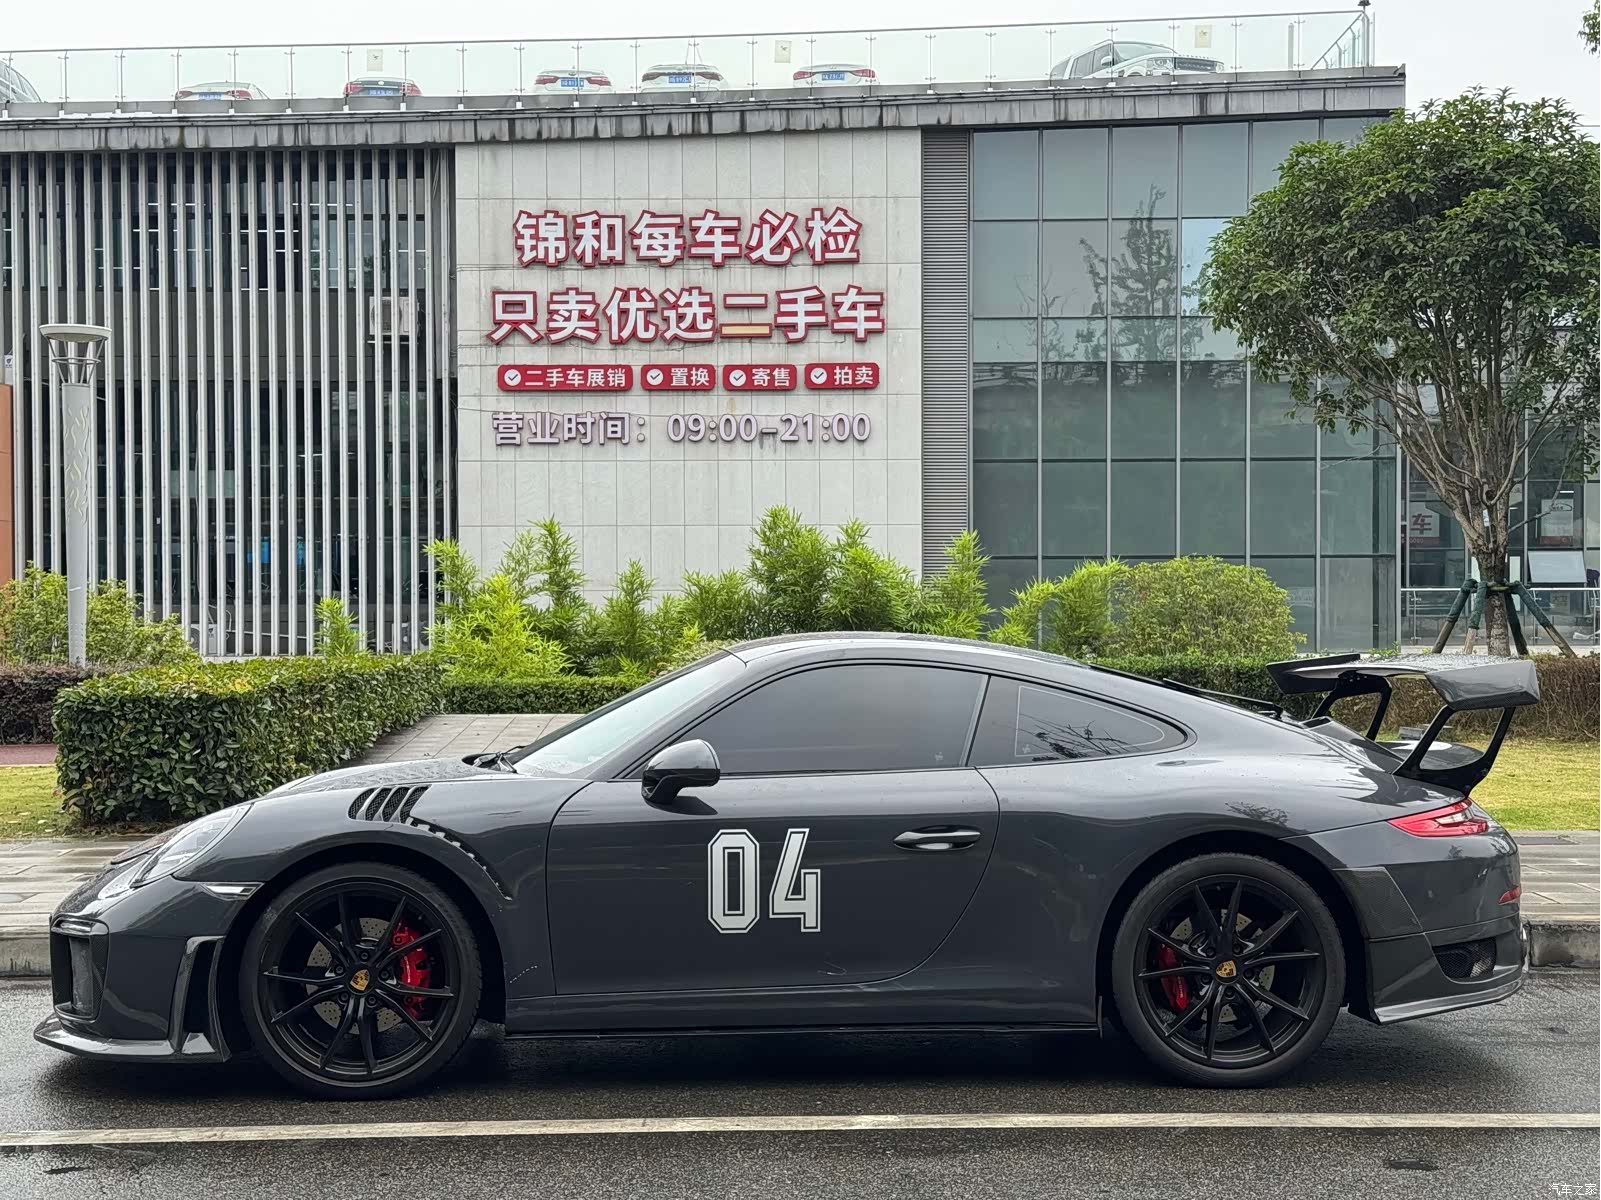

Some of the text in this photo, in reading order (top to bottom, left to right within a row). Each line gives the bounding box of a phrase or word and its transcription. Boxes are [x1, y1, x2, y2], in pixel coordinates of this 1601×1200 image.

[513, 207, 863, 267] 锦和每车必检
[487, 285, 885, 343] 只卖优选二手车
[524, 367, 626, 388] 二手车展销
[670, 366, 710, 387] 置换
[752, 367, 791, 387] 寄售
[834, 366, 874, 386] 拍卖
[707, 828, 821, 934] 04
